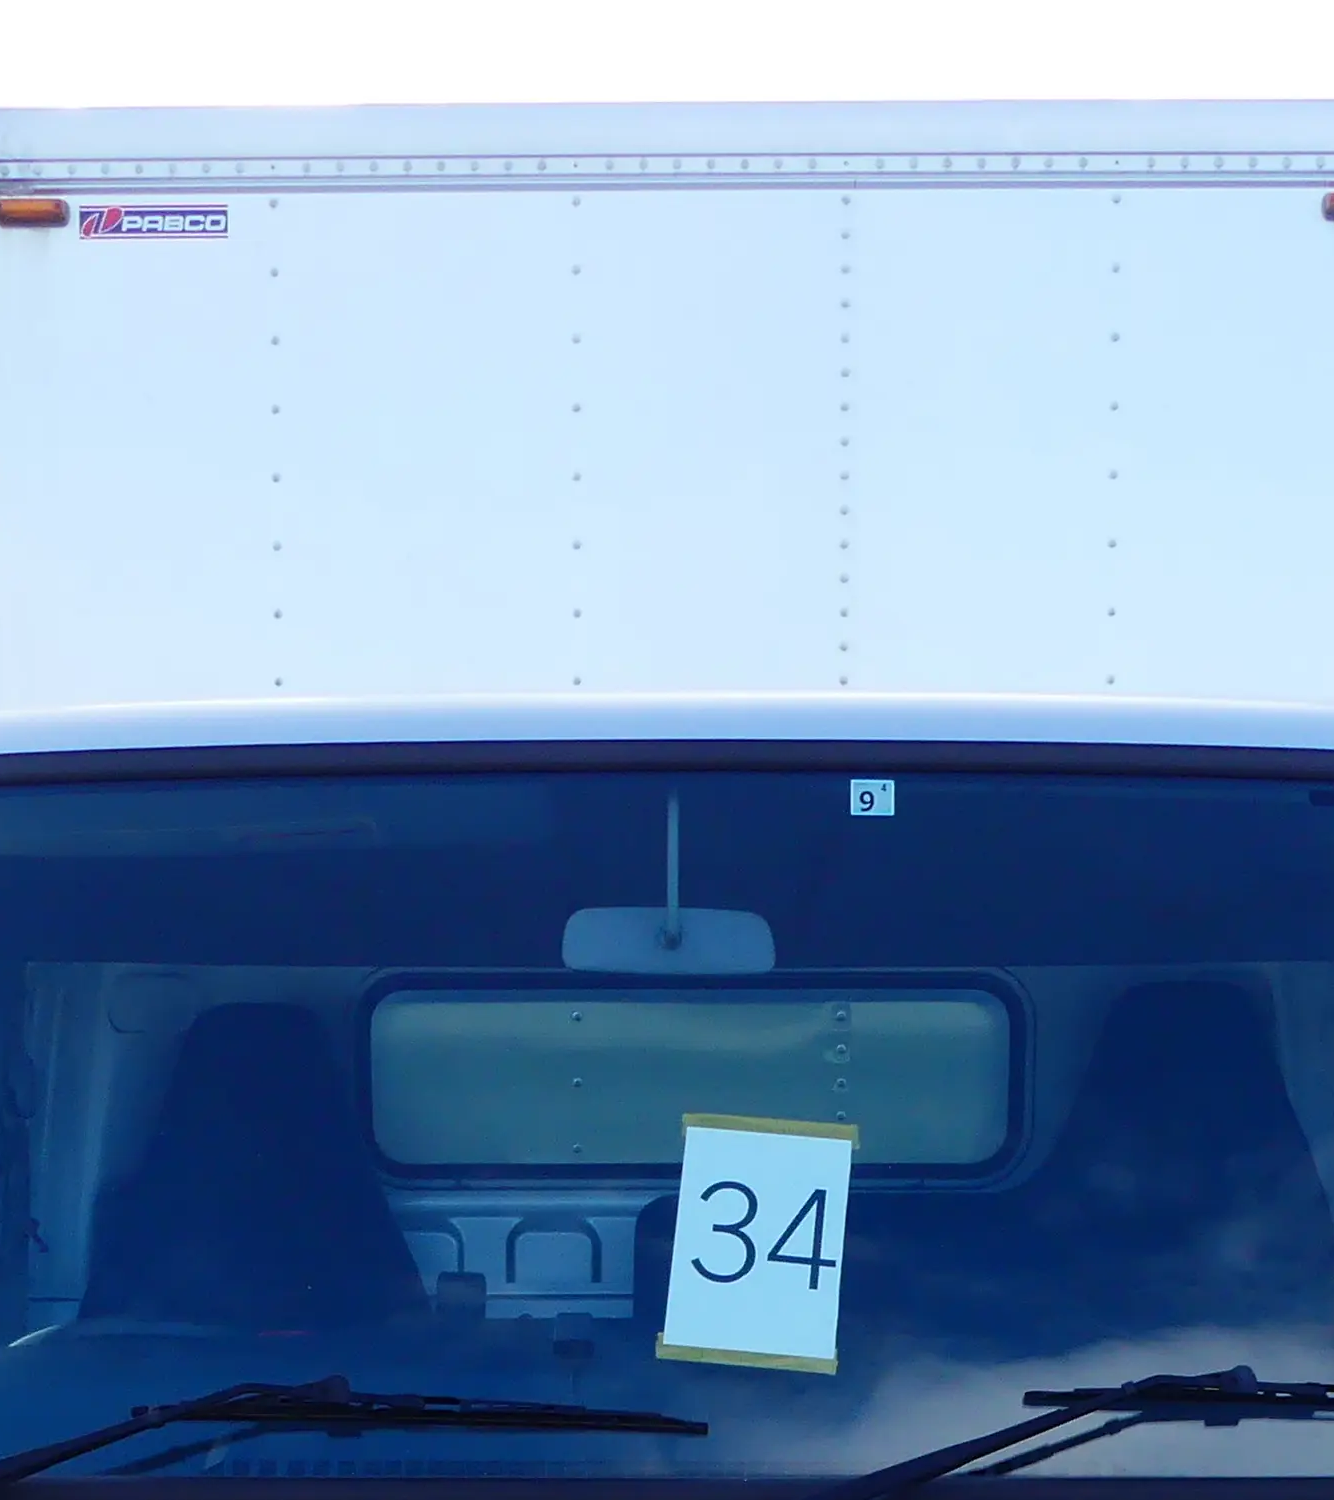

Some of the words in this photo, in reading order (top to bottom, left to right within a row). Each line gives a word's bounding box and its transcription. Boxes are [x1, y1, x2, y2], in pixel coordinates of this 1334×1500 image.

[121, 215, 226, 232] PABCO
[859, 791, 875, 812] 9
[690, 1180, 836, 1290] 34
